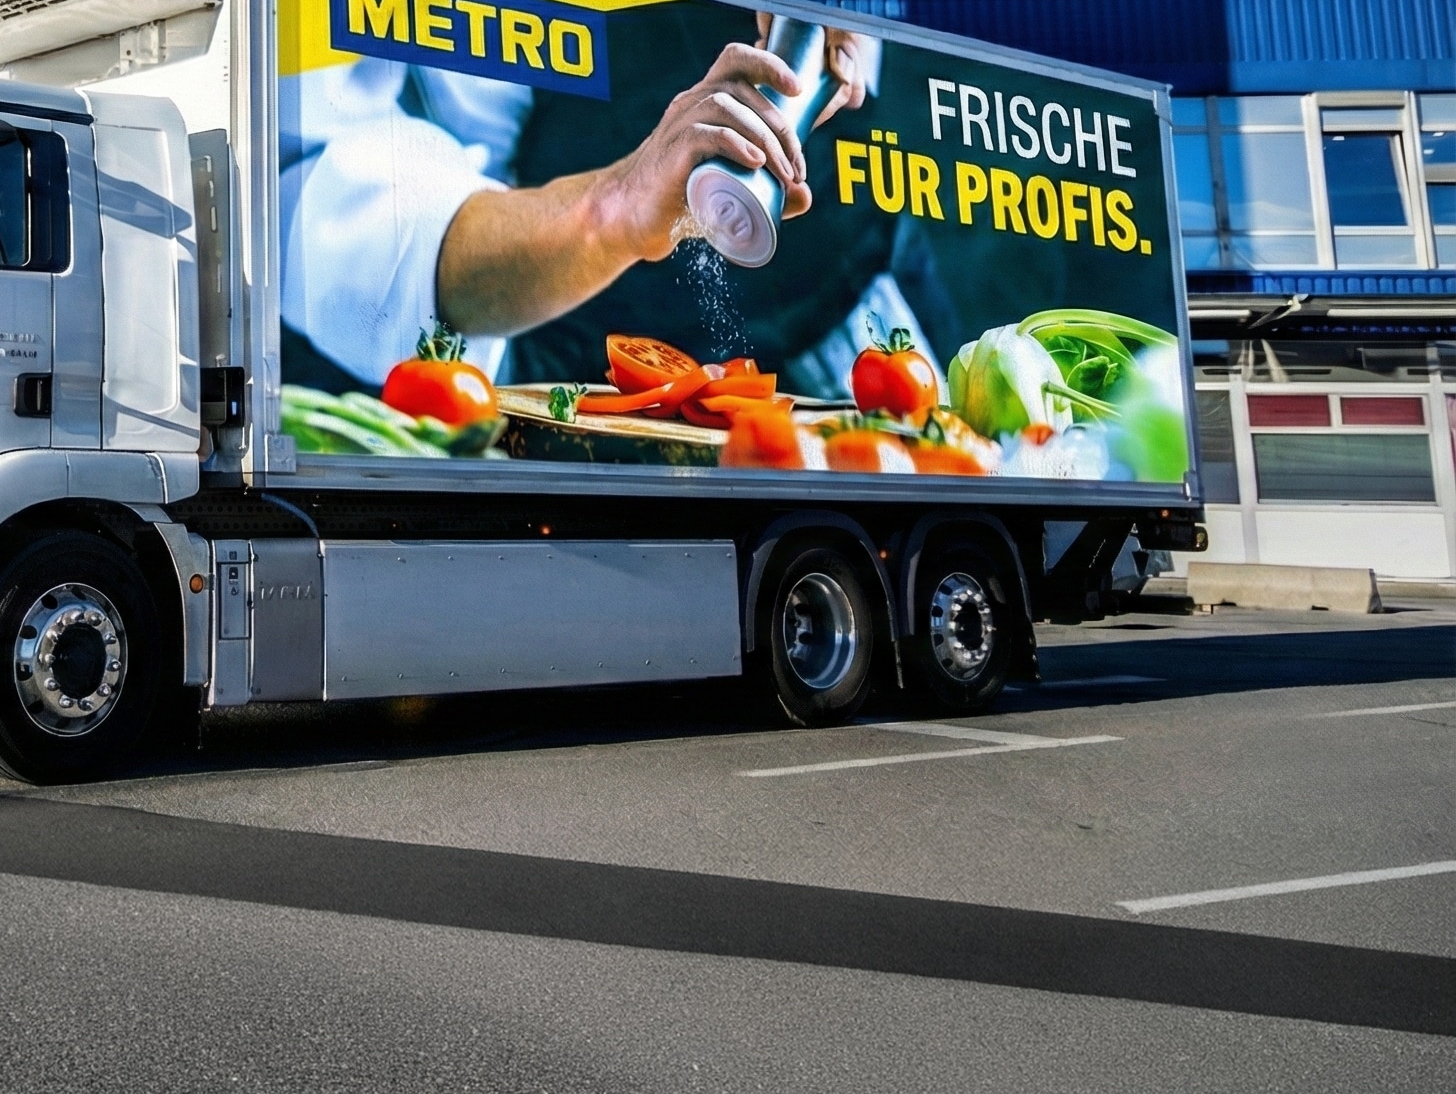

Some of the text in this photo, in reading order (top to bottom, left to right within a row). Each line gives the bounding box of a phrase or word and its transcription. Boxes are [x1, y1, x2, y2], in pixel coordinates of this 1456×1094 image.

[928, 77, 1136, 178] FRISCHE
[836, 129, 1152, 255] FÜR PROFIS.
